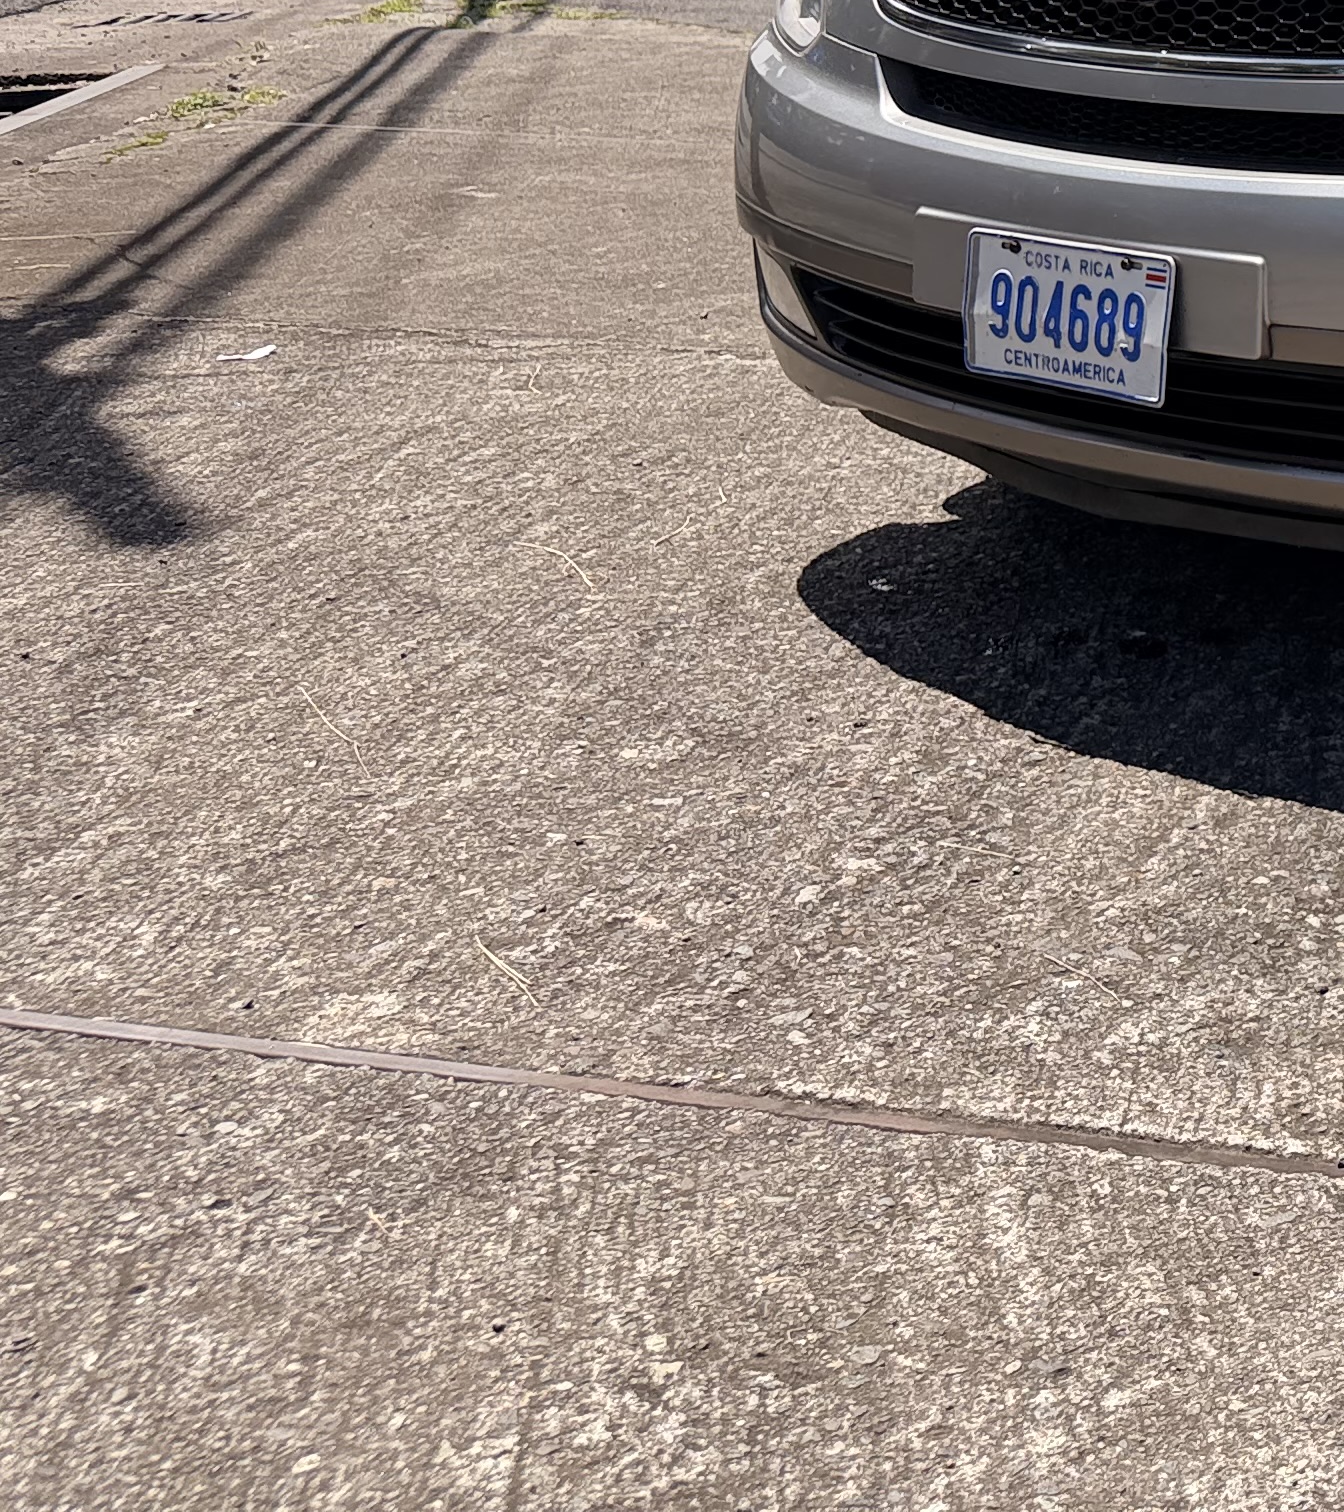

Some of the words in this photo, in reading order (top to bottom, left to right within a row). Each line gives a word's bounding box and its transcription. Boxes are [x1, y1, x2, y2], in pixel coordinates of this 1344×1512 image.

[1025, 250, 1070, 272] COSTA
[1080, 259, 1114, 279] RICA
[988, 268, 1146, 362] 904689
[1004, 348, 1126, 386] CENTROAMERICA
